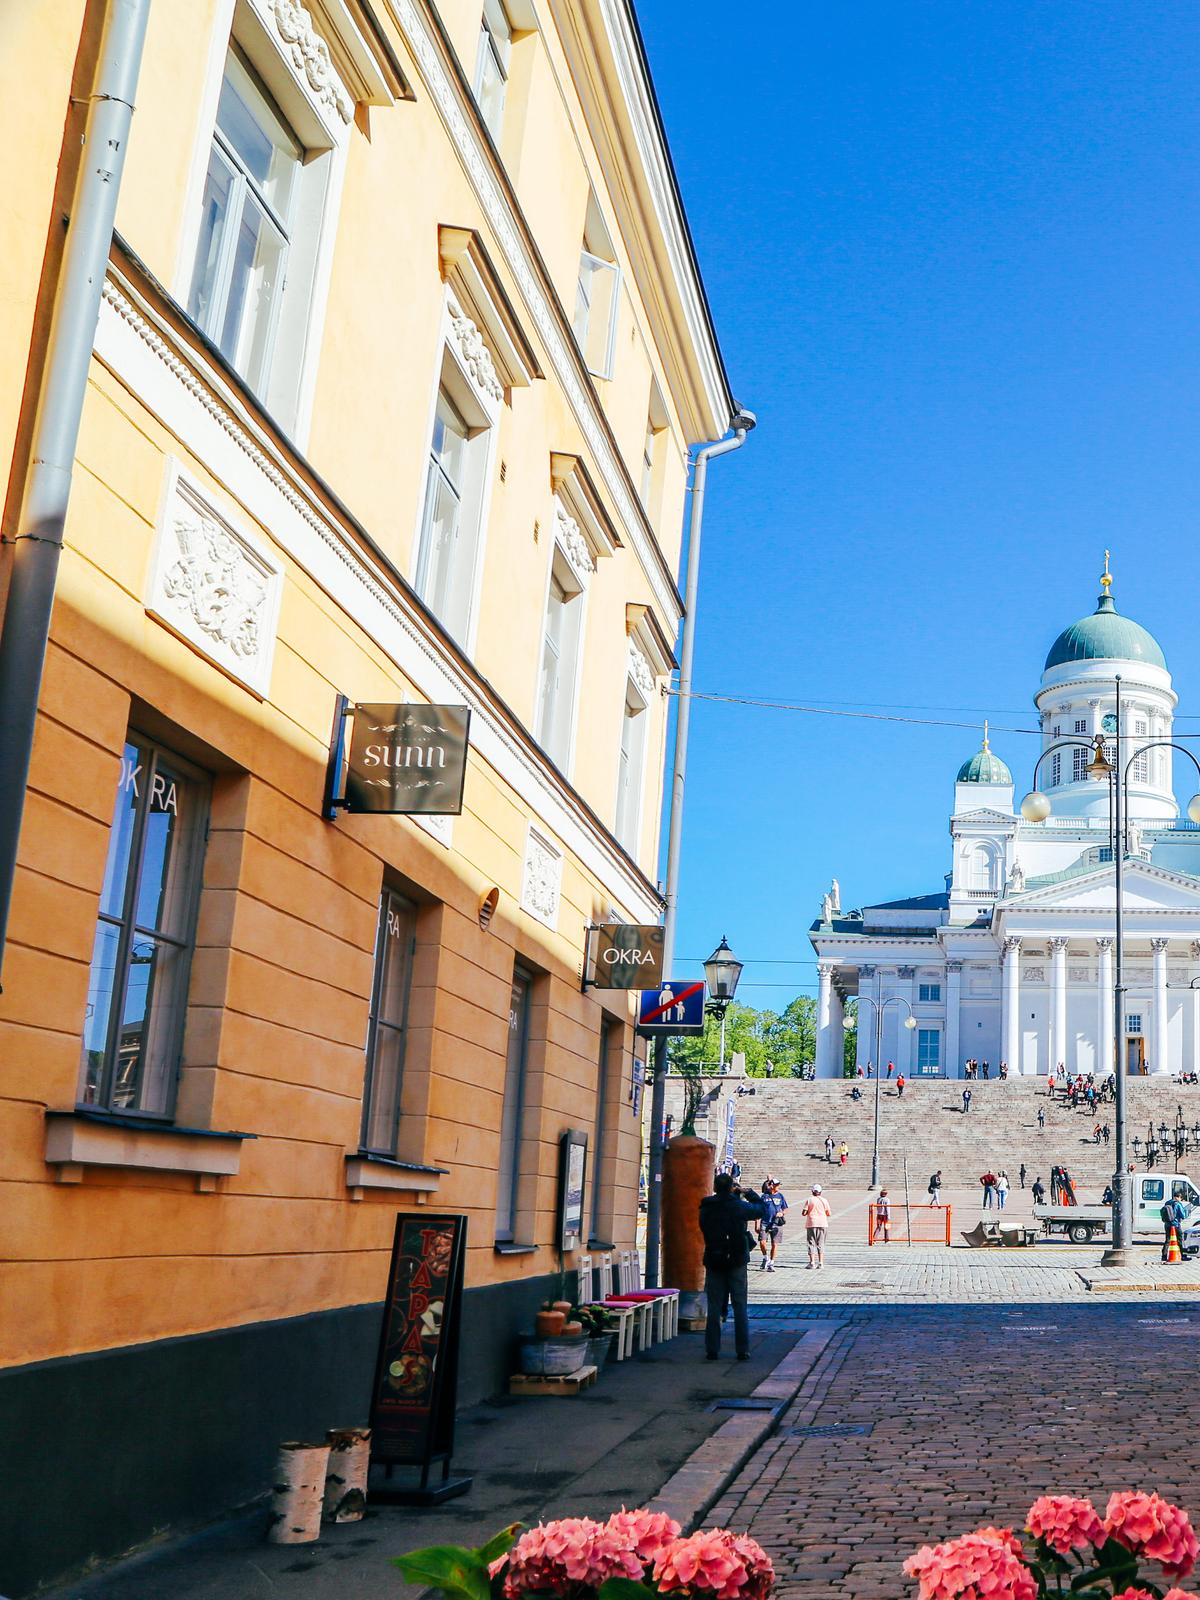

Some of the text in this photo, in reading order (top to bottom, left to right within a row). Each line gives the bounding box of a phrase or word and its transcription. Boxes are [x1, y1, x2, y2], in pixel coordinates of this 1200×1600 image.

[363, 744, 446, 768] sunn
[602, 948, 656, 966] OKRA
[400, 1229, 436, 1385] TAPAS
